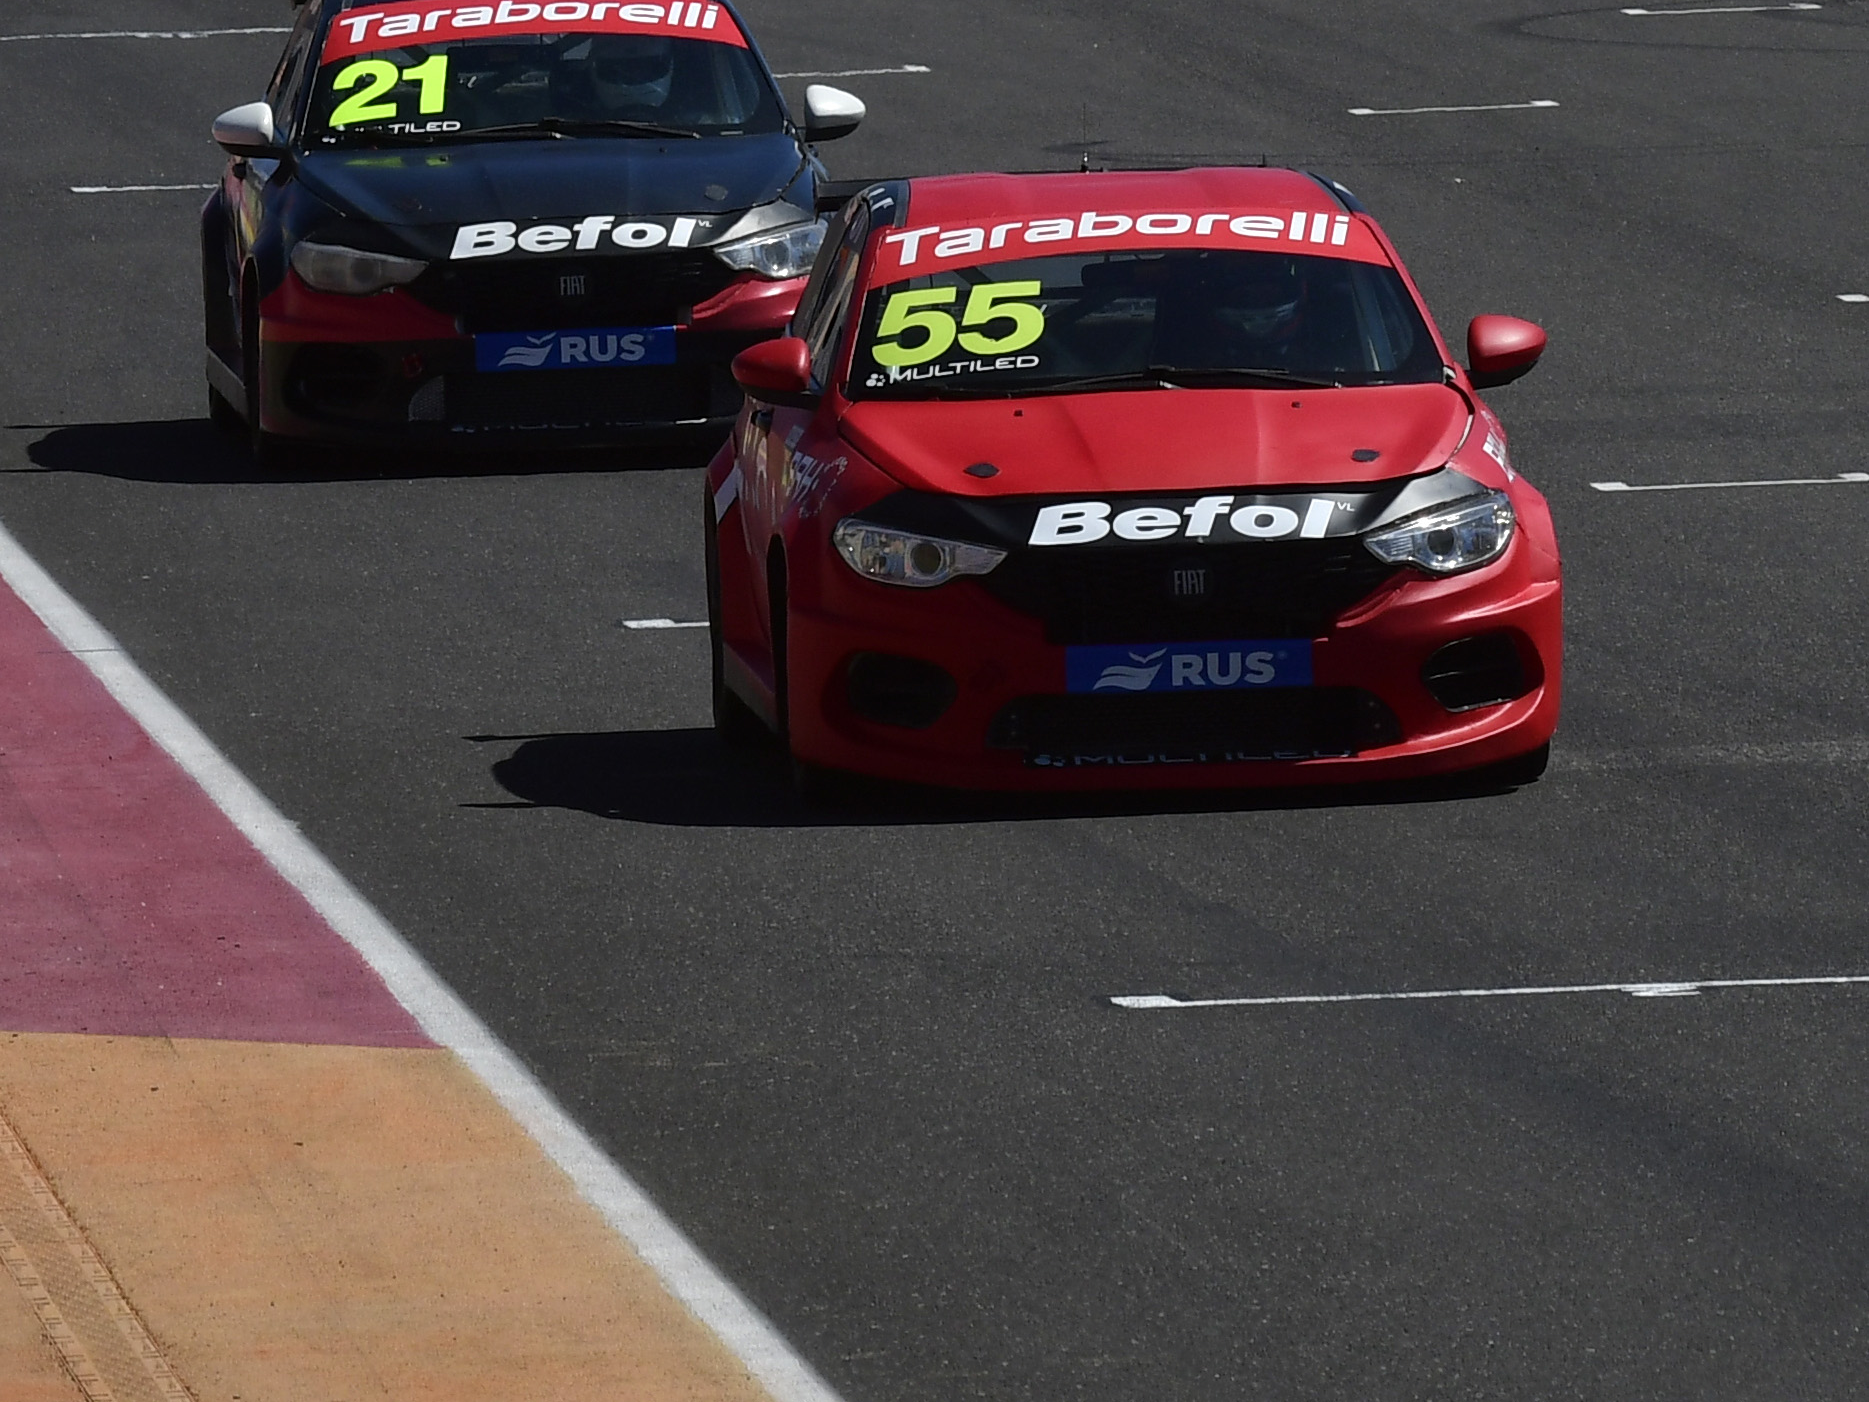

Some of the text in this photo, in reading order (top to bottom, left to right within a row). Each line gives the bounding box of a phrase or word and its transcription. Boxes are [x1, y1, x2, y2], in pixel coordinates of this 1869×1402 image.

[340, 0, 718, 43] Taraborelli
[329, 54, 447, 128] 21
[449, 215, 697, 259] Befol
[885, 210, 1349, 266] Taraborelli
[560, 275, 585, 296] FIAT
[871, 280, 1045, 368] 55
[561, 333, 647, 363] RUS
[888, 355, 1041, 385] MULTILED
[1028, 496, 1335, 546] Befol
[1174, 569, 1206, 596] FIAT
[1171, 651, 1276, 687] RUS
